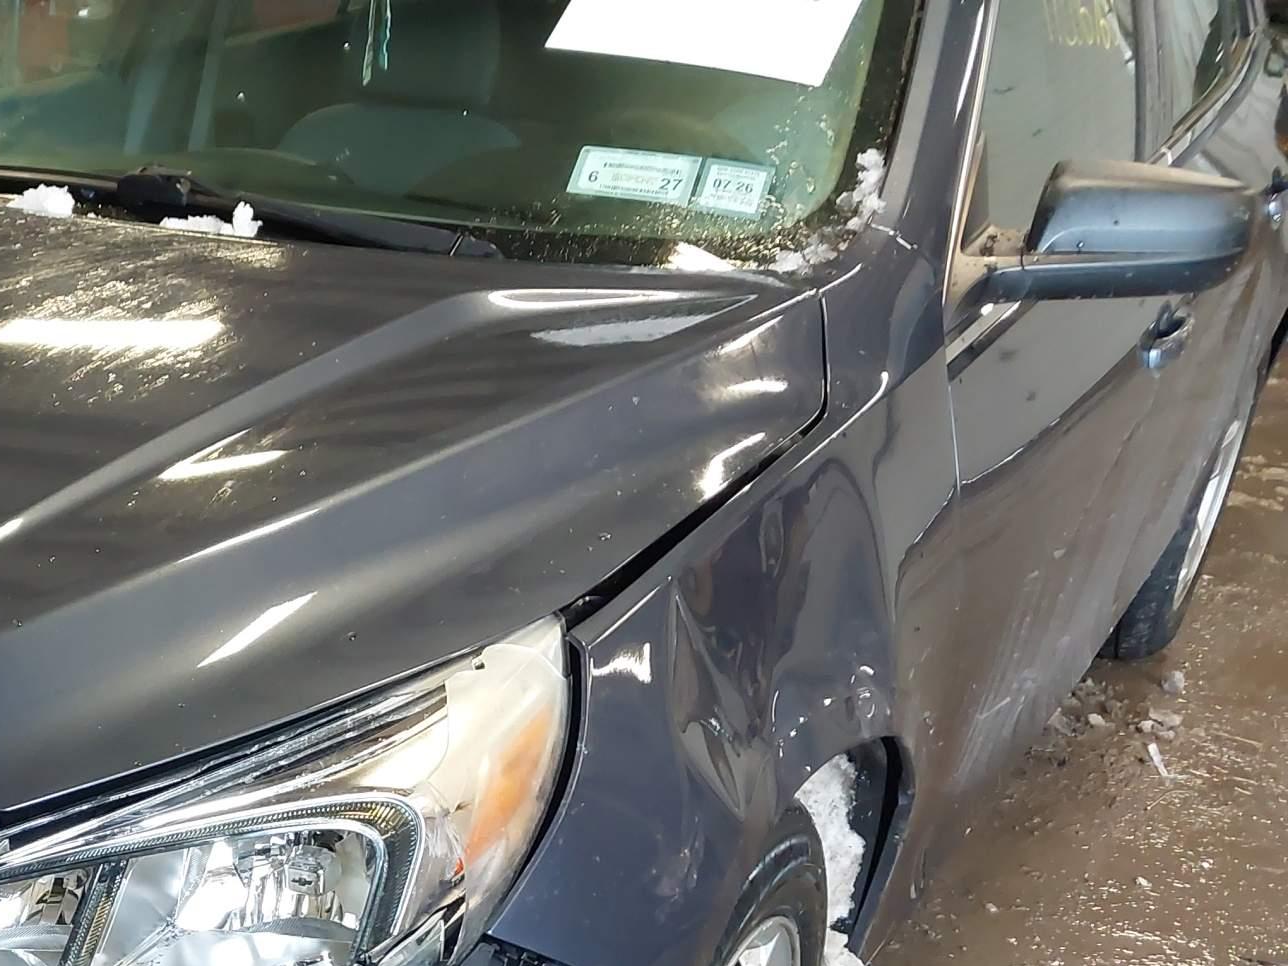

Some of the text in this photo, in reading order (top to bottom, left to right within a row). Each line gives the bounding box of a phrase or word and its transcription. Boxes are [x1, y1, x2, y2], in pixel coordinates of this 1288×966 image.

[588, 170, 599, 183] 6
[658, 177, 684, 192] 27
[713, 178, 754, 194] 07 26
